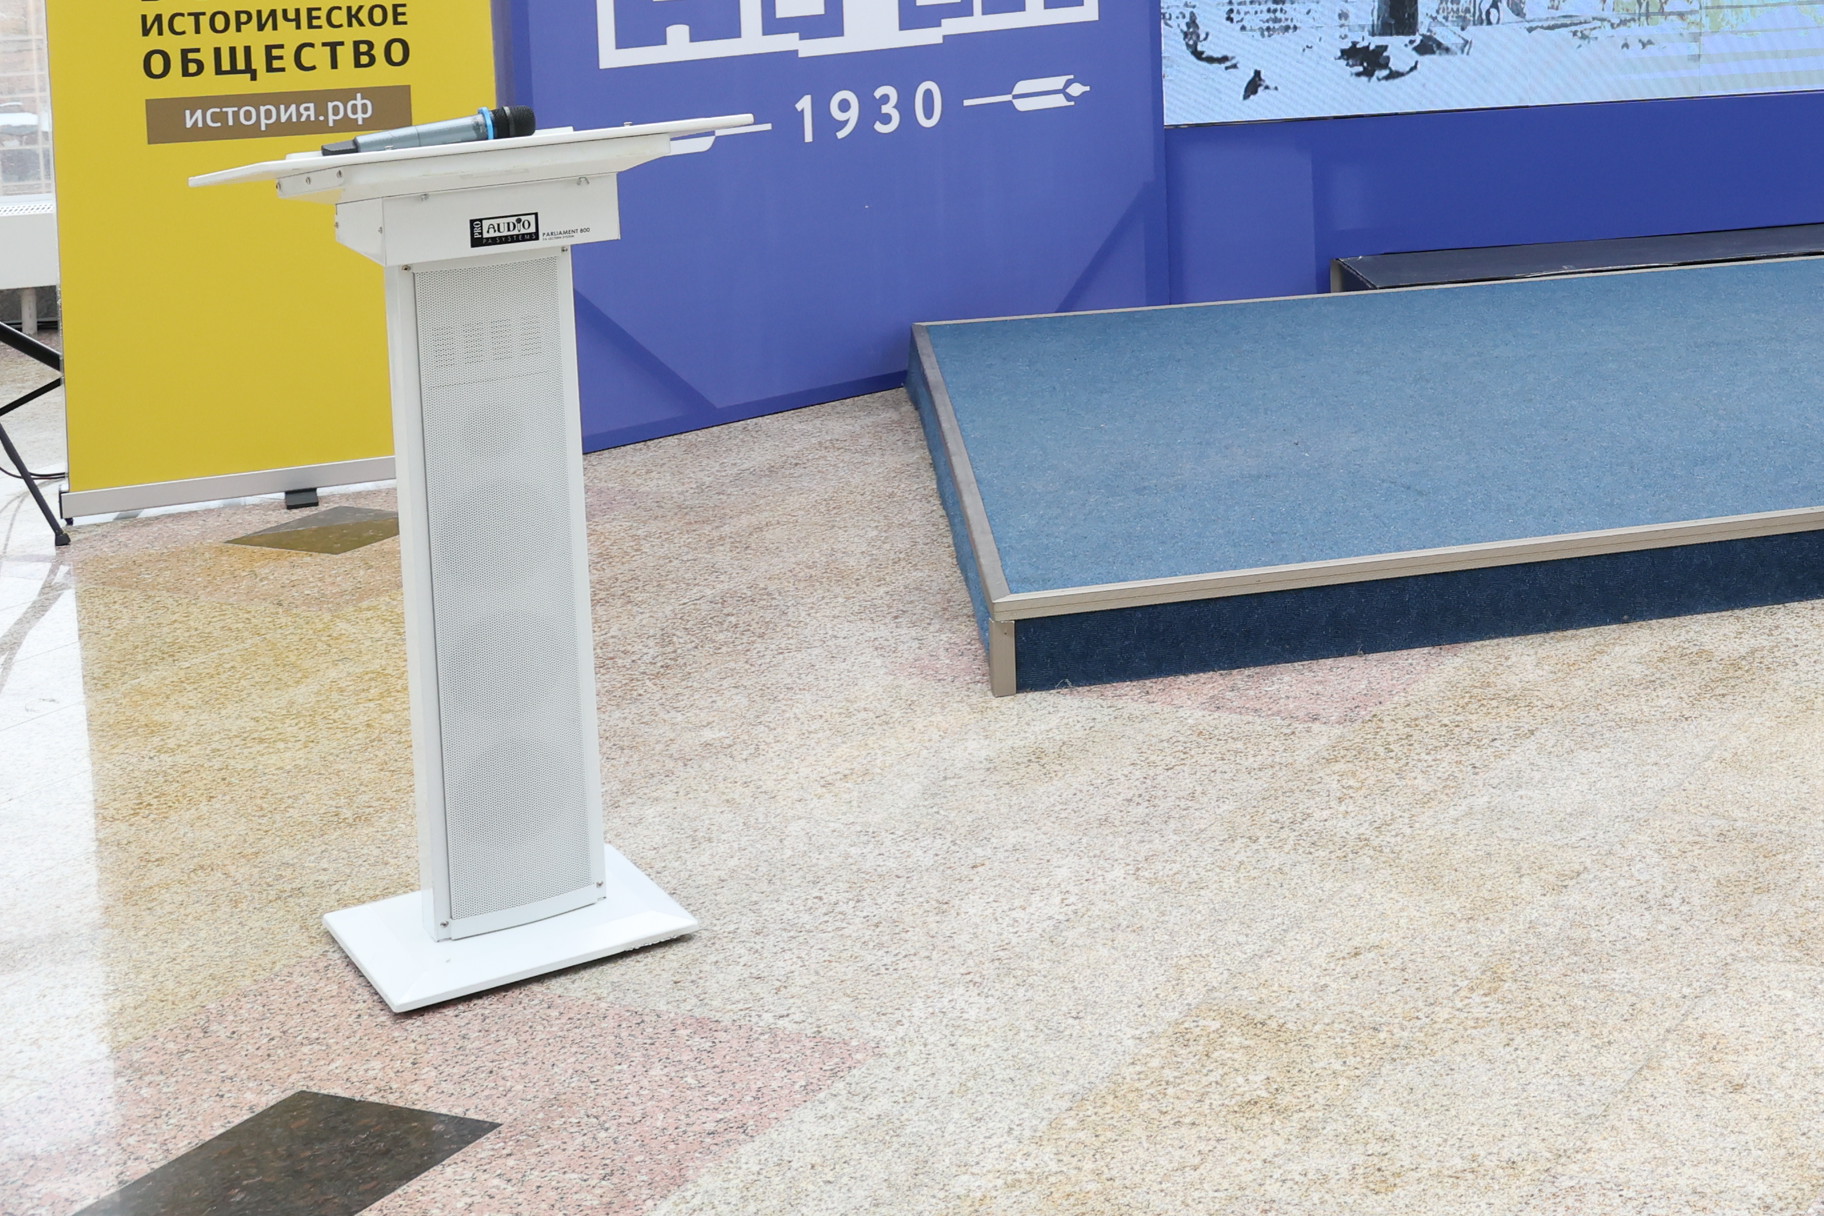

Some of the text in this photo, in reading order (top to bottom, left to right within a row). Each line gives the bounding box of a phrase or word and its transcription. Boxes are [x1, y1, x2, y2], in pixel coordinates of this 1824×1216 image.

[140, 3, 408, 37] ИСТОРИЧЕСКОЕ
[142, 37, 411, 81] ОБЩЕСТВО
[184, 92, 373, 131] история.рф
[794, 80, 943, 143] 1930
[473, 221, 482, 238] PRO
[486, 217, 531, 235] AUDIO
[495, 234, 536, 244] SYSTEMS
[542, 228, 579, 237] PARLIAMENT
